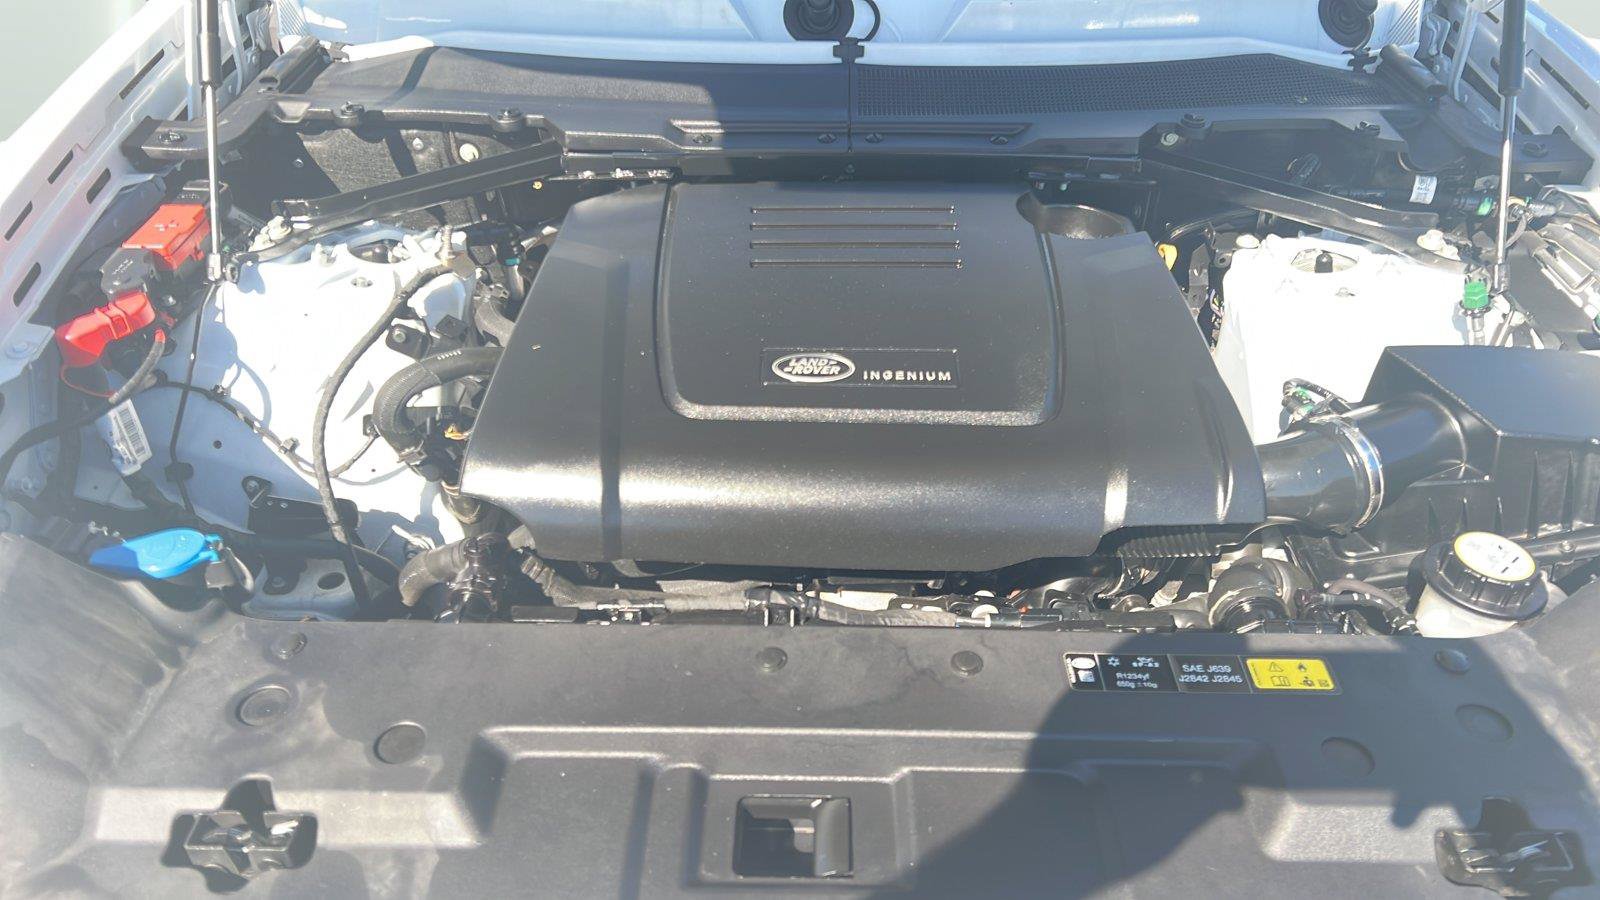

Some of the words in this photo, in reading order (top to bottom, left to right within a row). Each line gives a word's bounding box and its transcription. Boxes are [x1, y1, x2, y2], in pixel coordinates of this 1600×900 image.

[863, 370, 952, 381] INGENIUM
[1182, 664, 1205, 673] SAE
[1206, 665, 1232, 673] J639
[1115, 672, 1150, 681] R1234yf
[1178, 674, 1209, 683] J2842
[1211, 675, 1243, 683] J2845
